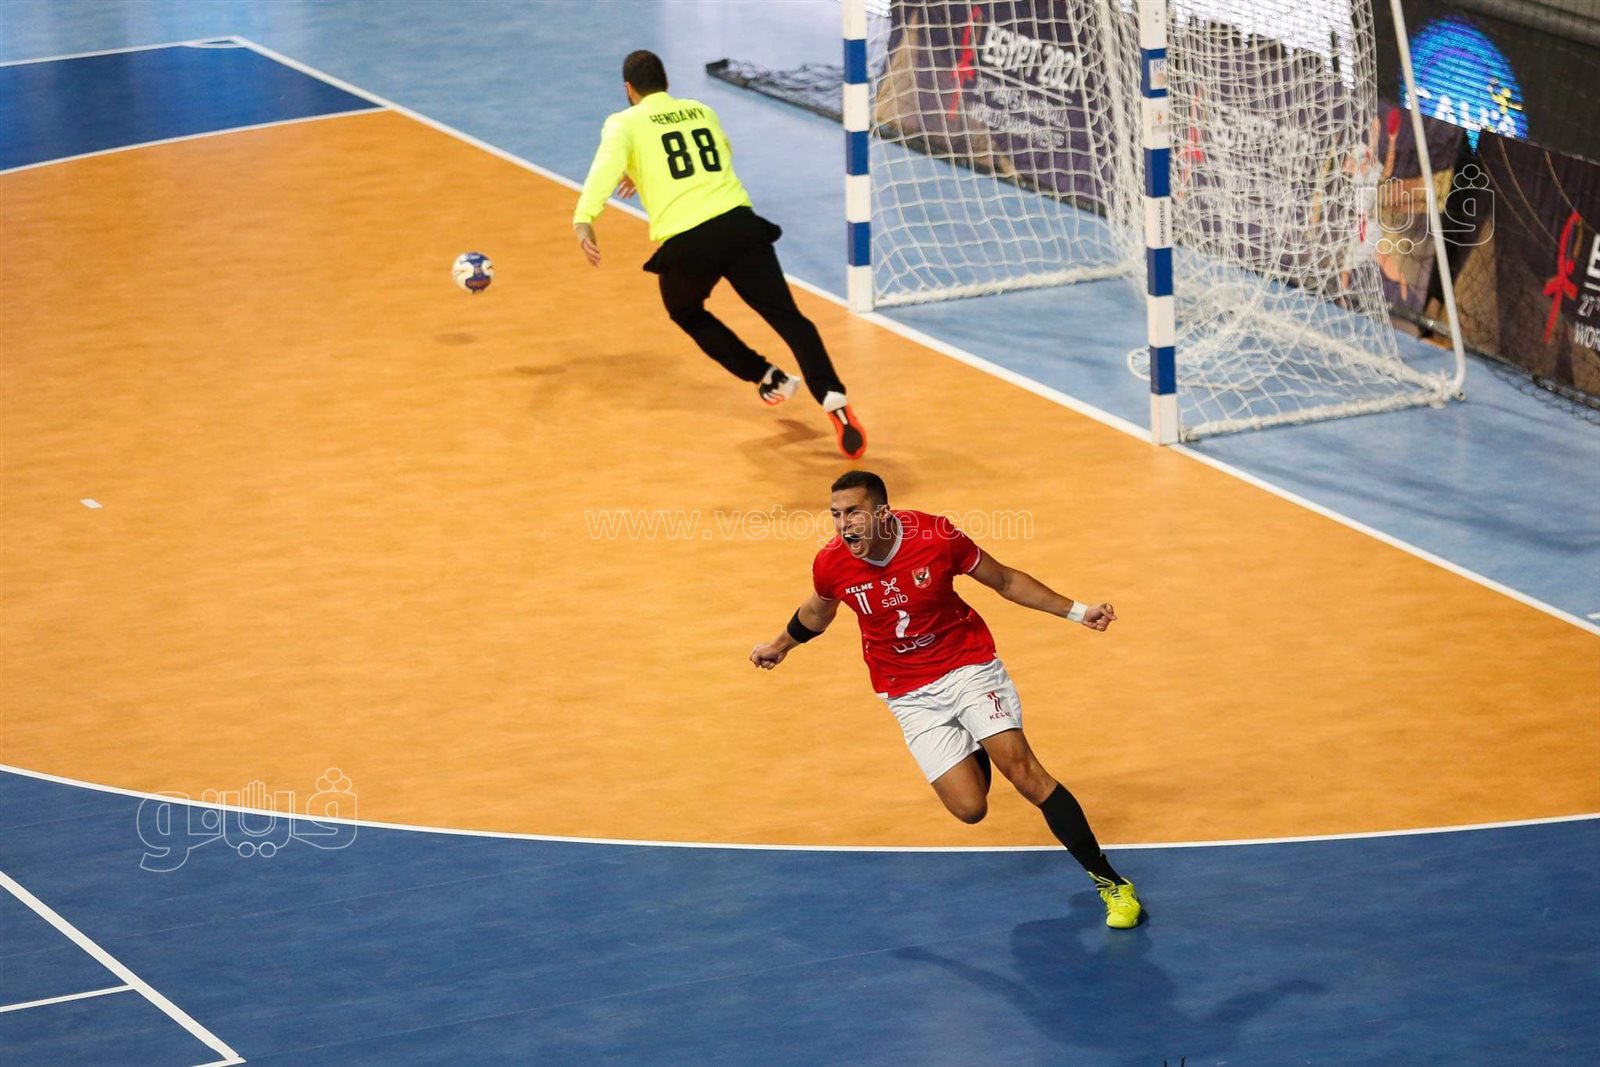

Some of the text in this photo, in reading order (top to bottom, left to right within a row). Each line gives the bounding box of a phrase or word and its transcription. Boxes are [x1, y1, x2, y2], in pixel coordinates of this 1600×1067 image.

[982, 25, 1081, 93] EGYPT 2021
[649, 107, 705, 125] HENDAWY
[661, 127, 722, 180] 88
[845, 582, 874, 595] KELME
[855, 591, 873, 615] 11
[881, 593, 909, 608] saib
